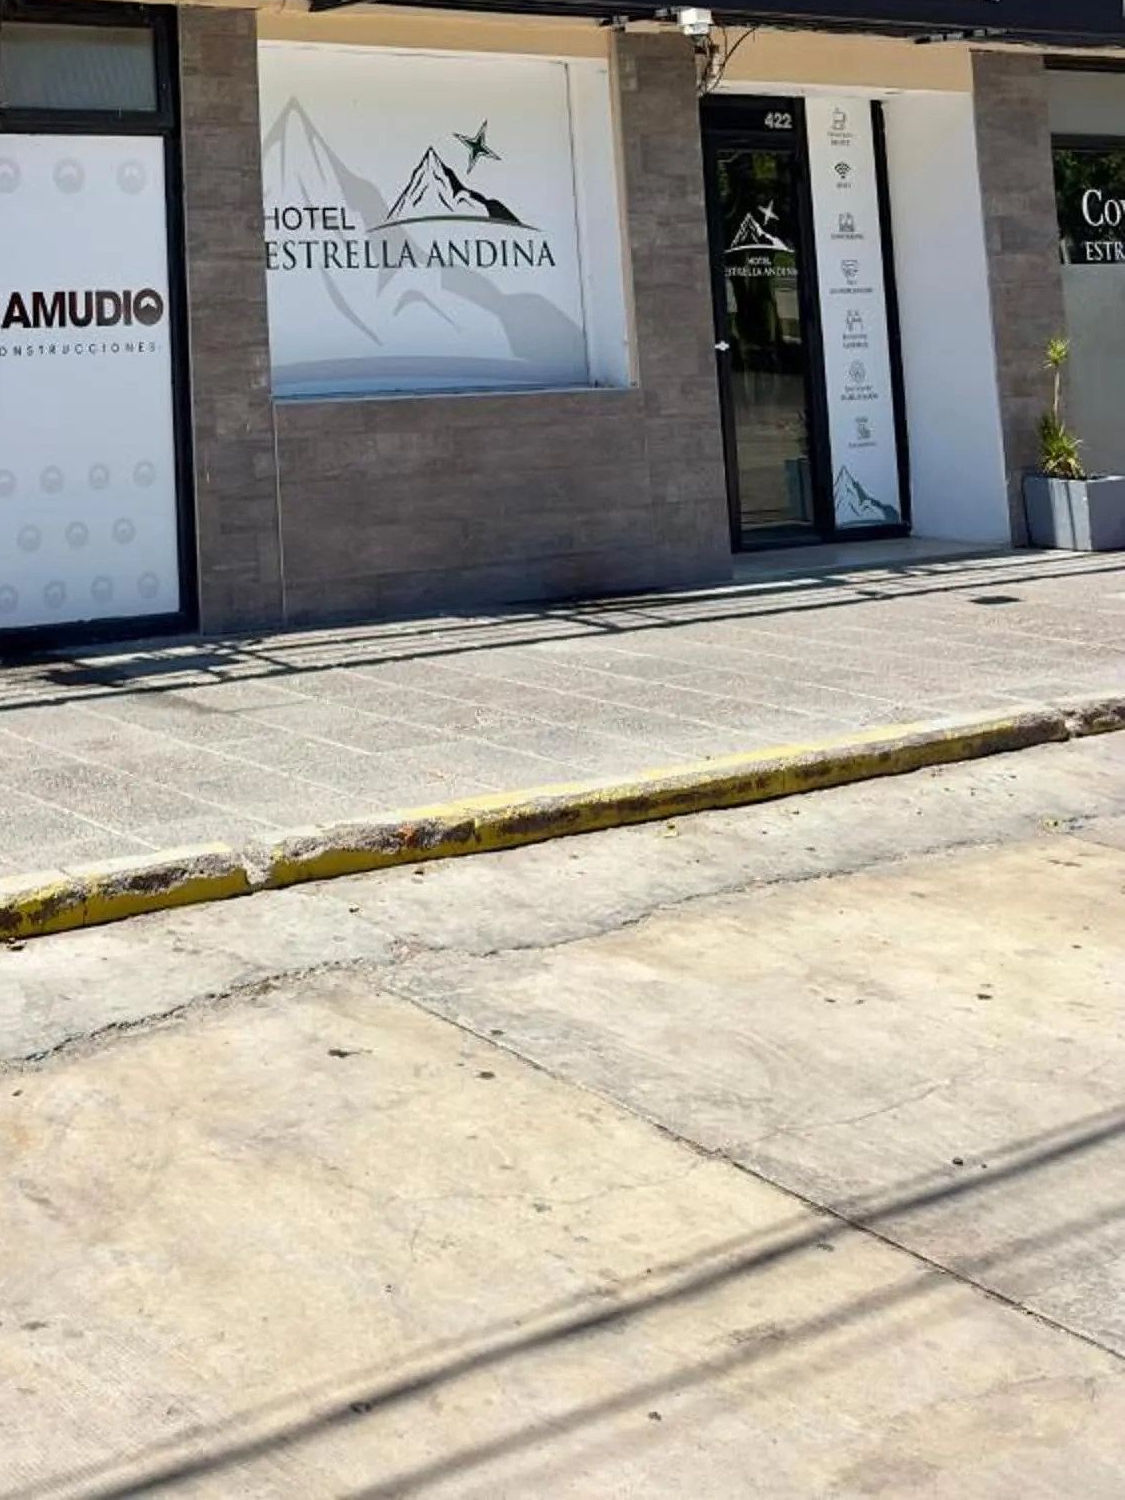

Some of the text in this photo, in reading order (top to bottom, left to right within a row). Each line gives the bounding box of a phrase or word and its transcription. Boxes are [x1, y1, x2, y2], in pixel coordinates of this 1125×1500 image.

[764, 112, 793, 129] 422
[265, 240, 556, 269] ESTRELLA ANDINA
